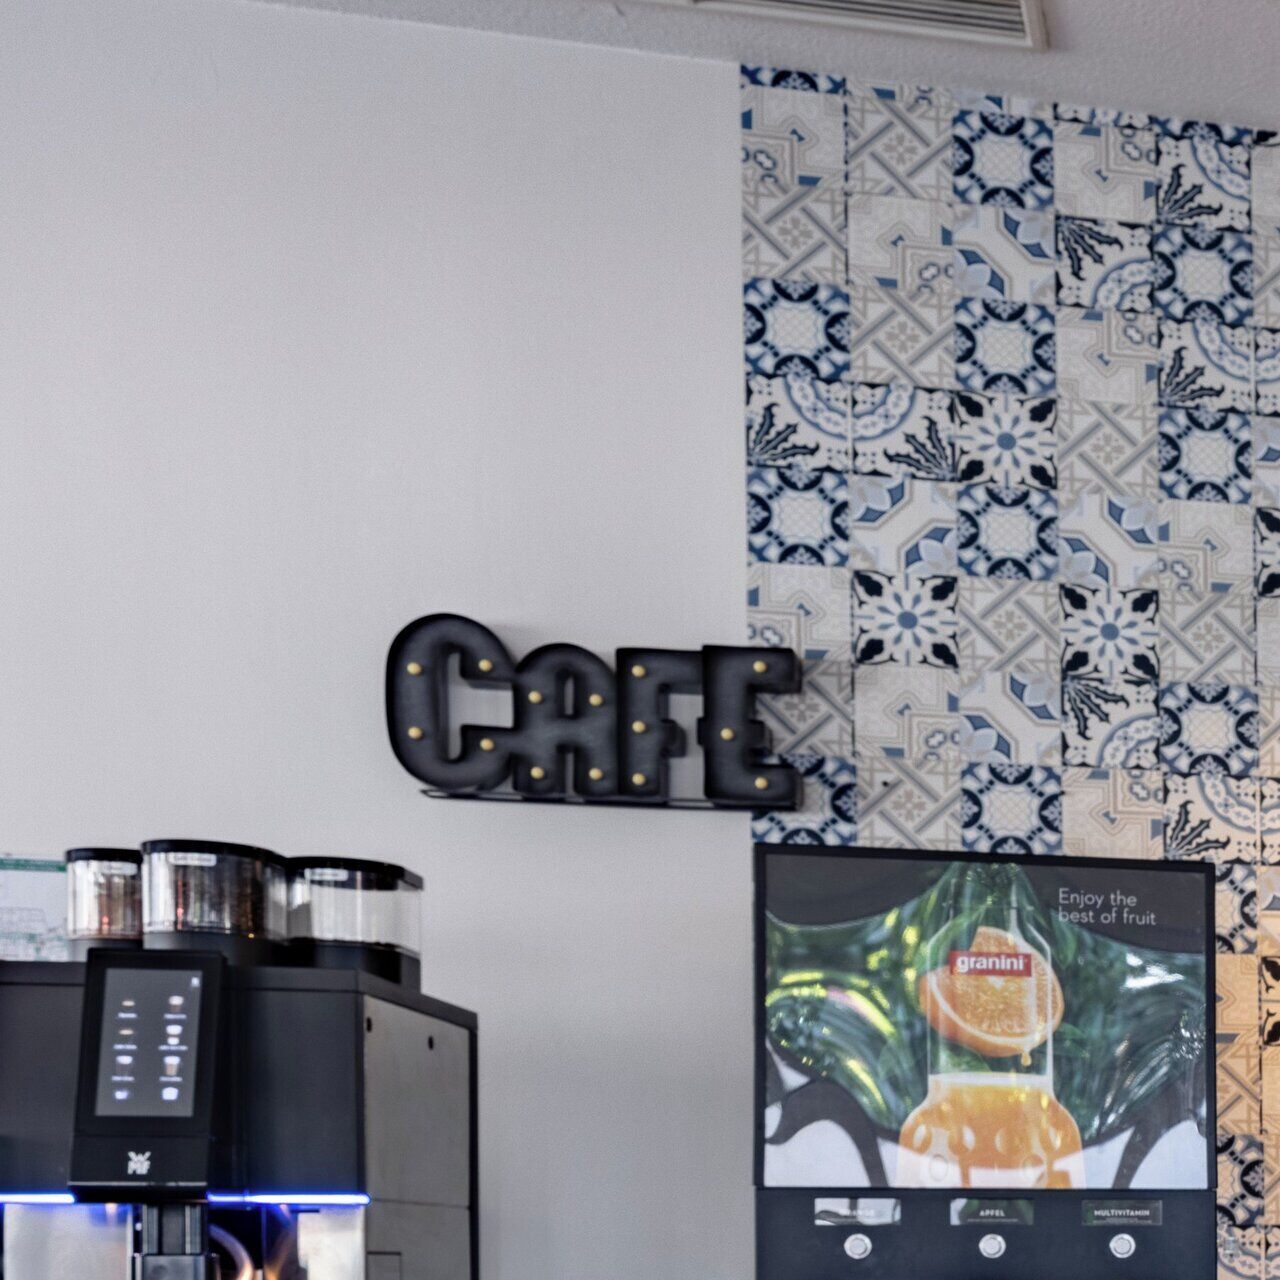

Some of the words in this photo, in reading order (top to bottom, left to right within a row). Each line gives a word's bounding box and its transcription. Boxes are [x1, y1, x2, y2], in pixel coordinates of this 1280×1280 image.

[385, 613, 800, 806] CAFE
[1059, 888, 1104, 908] Enjoy
[1110, 890, 1137, 907] the
[1059, 907, 1095, 924] best
[1101, 910, 1118, 924] of
[1123, 909, 1157, 926] fruit
[956, 954, 1025, 973] granini
[1094, 1209, 1150, 1217] MULTIVITAMIN
